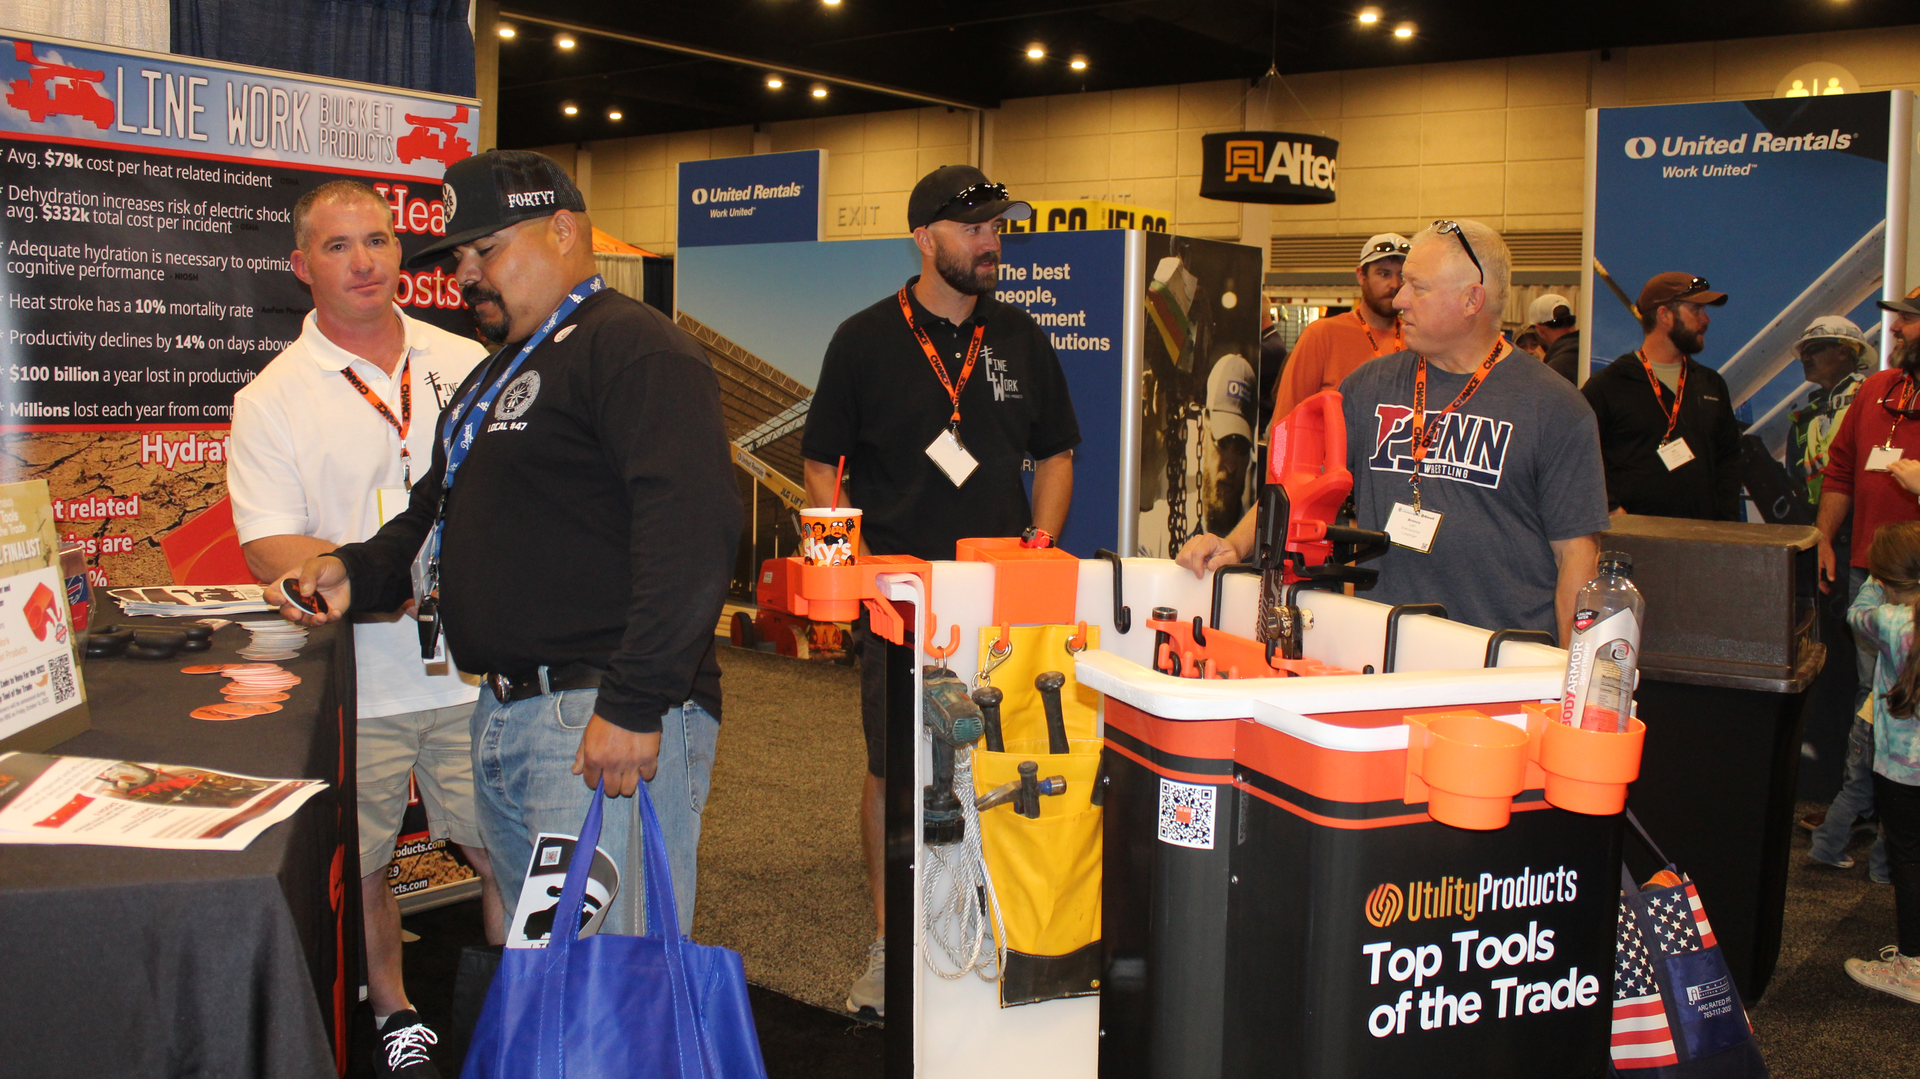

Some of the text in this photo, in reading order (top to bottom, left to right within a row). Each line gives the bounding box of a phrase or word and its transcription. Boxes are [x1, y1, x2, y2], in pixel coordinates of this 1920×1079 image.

[117, 66, 310, 153] LINE WORK
[319, 94, 394, 133] BUCKET
[319, 127, 394, 164] PRODUCTS
[1662, 134, 1747, 156] United
[8, 148, 41, 171] Avg.
[44, 149, 83, 169] $79k
[86, 156, 114, 173] cost
[117, 161, 140, 177] per
[143, 159, 173, 178] heat
[176, 164, 220, 183] related
[223, 168, 272, 188] incident
[1263, 141, 1336, 192] Altec
[1662, 166, 1698, 178] Work
[8, 184, 291, 224] Dehydration increases risk of electric shock
[507, 190, 554, 208] FORTY7
[710, 186, 751, 203] United
[6, 205, 38, 223] avg.
[42, 202, 90, 223] $332k
[93, 209, 123, 226] total
[126, 212, 154, 228] cost
[157, 217, 179, 232] per
[182, 215, 233, 234] incident
[710, 208, 728, 219] Work
[838, 206, 880, 226] EXIT
[8, 239, 81, 263] Adequate
[84, 243, 148, 265] hydration
[151, 248, 162, 264] is
[165, 251, 228, 273] necessary
[231, 254, 244, 269] to
[7, 259, 75, 278] cognitive
[79, 263, 165, 281] performance
[997, 263, 1071, 281] The best
[9, 293, 254, 321] Heat stroke has a 10% mortality rate
[9, 329, 97, 350] Productivity
[100, 332, 153, 349] declines
[156, 334, 172, 352] by
[175, 335, 205, 350] 14%
[208, 337, 224, 350] on
[227, 336, 255, 354] days
[9, 364, 50, 383] $100
[54, 366, 99, 382] billion
[103, 370, 111, 382] a
[113, 370, 143, 386] year
[146, 368, 170, 383] lost
[173, 368, 185, 383] in
[1416, 381, 1425, 416] CHANCE
[1452, 376, 1481, 409] CHANCE
[10, 402, 70, 417] Millions
[74, 402, 98, 417] lost
[102, 402, 133, 417] each
[136, 404, 164, 421] year
[167, 401, 200, 417] from
[487, 422, 528, 434] LOCAL #47
[1368, 403, 1513, 474] PENN
[1423, 463, 1469, 479] WRESTLING
[70, 495, 138, 518] related
[791, 494, 804, 509] LIFT
[2, 537, 41, 564] FINALIST
[102, 537, 132, 553] are
[391, 879, 428, 895] cts.com
[1362, 921, 1555, 987] Top Tools
[1367, 967, 1599, 1038] of the Trade
